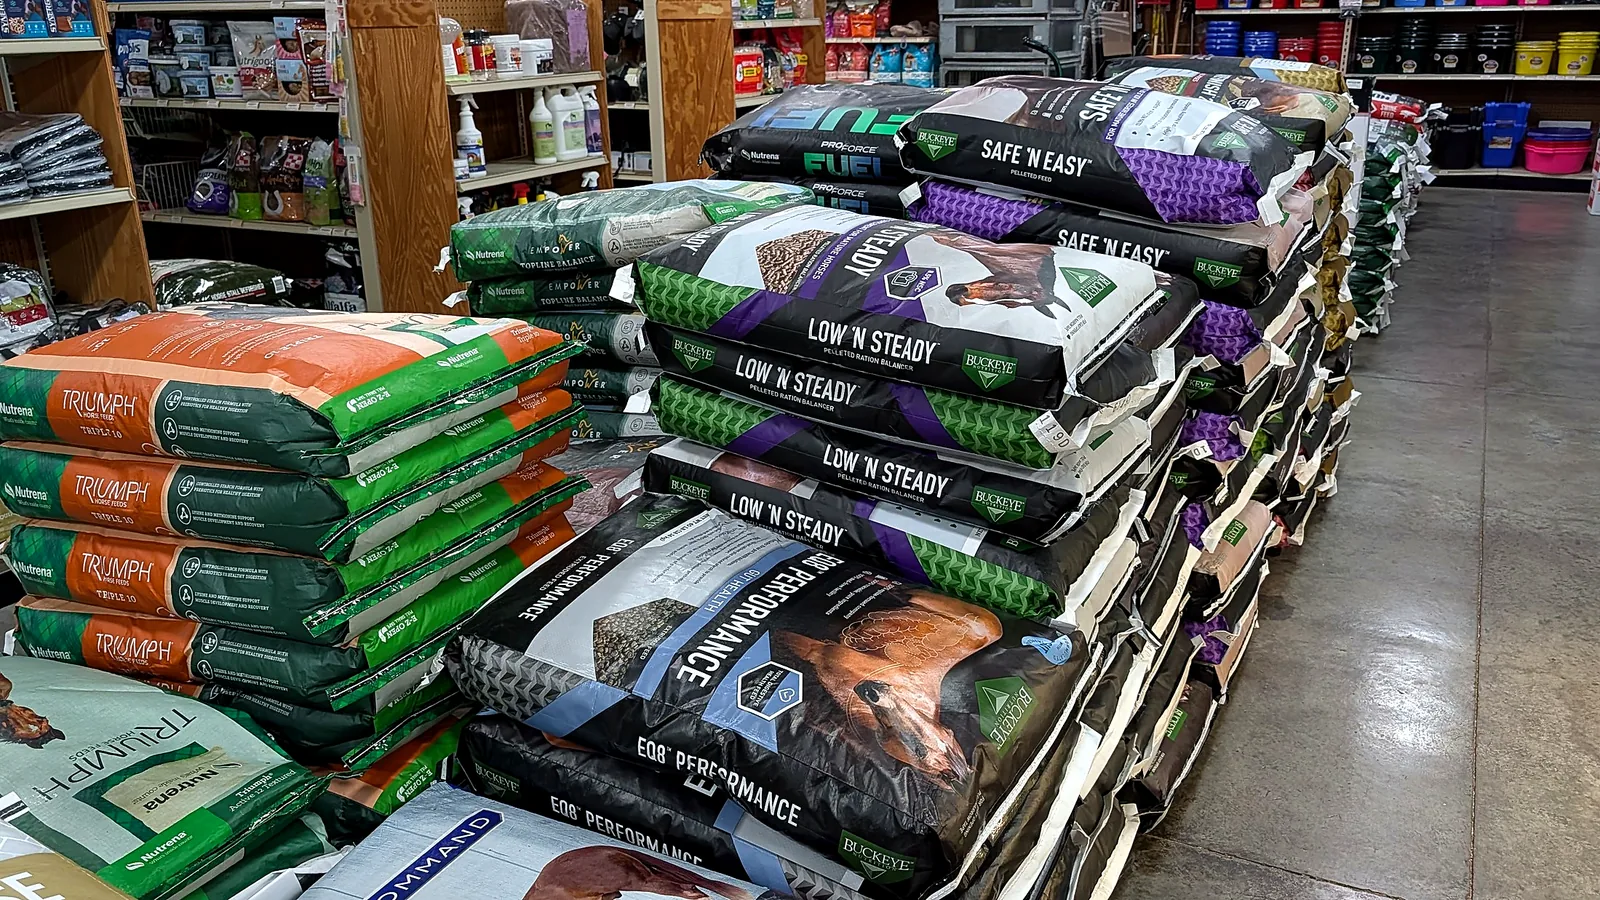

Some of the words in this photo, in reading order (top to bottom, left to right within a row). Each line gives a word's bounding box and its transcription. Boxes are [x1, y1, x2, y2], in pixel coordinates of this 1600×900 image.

[1079, 89, 1122, 122] SAFE
[821, 140, 877, 154] PROFORCE
[918, 131, 955, 147] BUCKEYE
[751, 151, 779, 161] Nutrena
[981, 139, 1023, 165] SAFE
[1043, 151, 1087, 177] EASY
[804, 153, 882, 178] FUEL
[1010, 169, 1037, 180] PELLETED
[1038, 174, 1052, 183] FEED
[812, 183, 866, 198] PROFORCE
[475, 250, 505, 260] Nutrena
[1058, 228, 1098, 253] SAFE
[1120, 241, 1165, 267] EASY
[520, 261, 555, 270] TOPLINE
[556, 256, 595, 268] BALANCE
[813, 251, 836, 280] HORSES
[1197, 261, 1239, 278] BUCKEYE
[496, 287, 525, 296] Nutrena
[541, 297, 570, 306] TOPLINE
[517, 333, 533, 344] Triple
[808, 317, 848, 346] LOW
[852, 325, 867, 350] 'N
[870, 330, 937, 365] STEADY
[447, 347, 480, 365] Nutrena
[674, 338, 713, 361] BUCKEYE
[823, 347, 855, 359] PELLETED
[855, 353, 880, 365] RATION
[880, 358, 914, 372] BALANCER
[965, 353, 1014, 374] BUCKEYE
[735, 355, 773, 384] LOW
[776, 366, 792, 390] 'N
[794, 371, 857, 405] STEADY
[62, 389, 137, 418] TRIUMPH
[522, 399, 539, 410] Triple
[749, 383, 779, 398] PELLETED
[779, 392, 801, 403] RATION
[802, 398, 835, 412] BALANCER
[0, 402, 33, 418] Nutrena
[454, 416, 485, 434] Nutrena
[112, 430, 123, 439] 10
[365, 470, 388, 485] OPEN
[386, 464, 400, 475] E-Z
[521, 471, 537, 481] Triple
[823, 443, 860, 473] LOW
[863, 456, 880, 480] 'N
[881, 462, 949, 498] STEADY
[14, 485, 47, 501] Nutrena
[75, 475, 148, 503] TRIUMPH
[671, 479, 710, 500] BUCKEYE
[837, 472, 868, 486] PELLETED
[867, 481, 891, 494] RATION
[890, 489, 925, 503] BALANCER
[94, 498, 110, 507] HORSE
[453, 491, 483, 509] Nutrena
[974, 490, 1023, 513] BUCKEYE
[91, 511, 122, 524] TRIPLE
[123, 516, 134, 525] 10
[730, 493, 764, 520] LOW
[768, 503, 782, 527] 'N
[785, 510, 845, 547] STEADY
[526, 525, 550, 541] Triumph
[534, 535, 548, 547] Triple
[608, 537, 635, 554] EQ8
[365, 549, 388, 565] OPEN
[802, 552, 845, 573] EQ8
[19, 562, 52, 578] Nutrena
[82, 552, 152, 583] TRIUMPH
[469, 559, 497, 578] Nutrena
[740, 569, 761, 583] GUT
[245, 573, 267, 581] DIGESTION
[518, 546, 613, 621] PERFORMANCE
[96, 589, 126, 603] TRIPLE
[126, 594, 137, 604] 10
[705, 579, 742, 613] HEALTH
[404, 614, 418, 628] E-Z
[676, 564, 816, 688] PERFORMANCE
[386, 623, 406, 639] OPEN
[37, 646, 71, 660] Nutrena
[96, 633, 172, 663] TRIUMPH
[759, 670, 775, 687] HEALTH
[769, 670, 784, 682] TOTAL
[750, 685, 761, 700] FEED
[753, 682, 773, 707] DIGESTIVE
[269, 703, 290, 716] DIGESTION
[989, 686, 1033, 750] BUCKEYE
[102, 730, 135, 748] HORSE
[32, 709, 197, 800] TRIUMPH
[68, 744, 102, 762] FEEDS
[420, 769, 433, 783] E-Z
[475, 762, 519, 794] BUCKEYE
[638, 736, 666, 764] EQ8
[676, 750, 801, 827] PERFORMANCE
[143, 769, 219, 811] Nutrena
[229, 792, 256, 812] Active
[263, 769, 296, 790] Textured
[235, 773, 270, 798] Triumph
[404, 779, 421, 797] OPEN
[551, 796, 578, 821] EQ8
[140, 831, 187, 862] Nutrena
[843, 837, 911, 872] BUCKEYE
[375, 815, 491, 900] OMMAND
